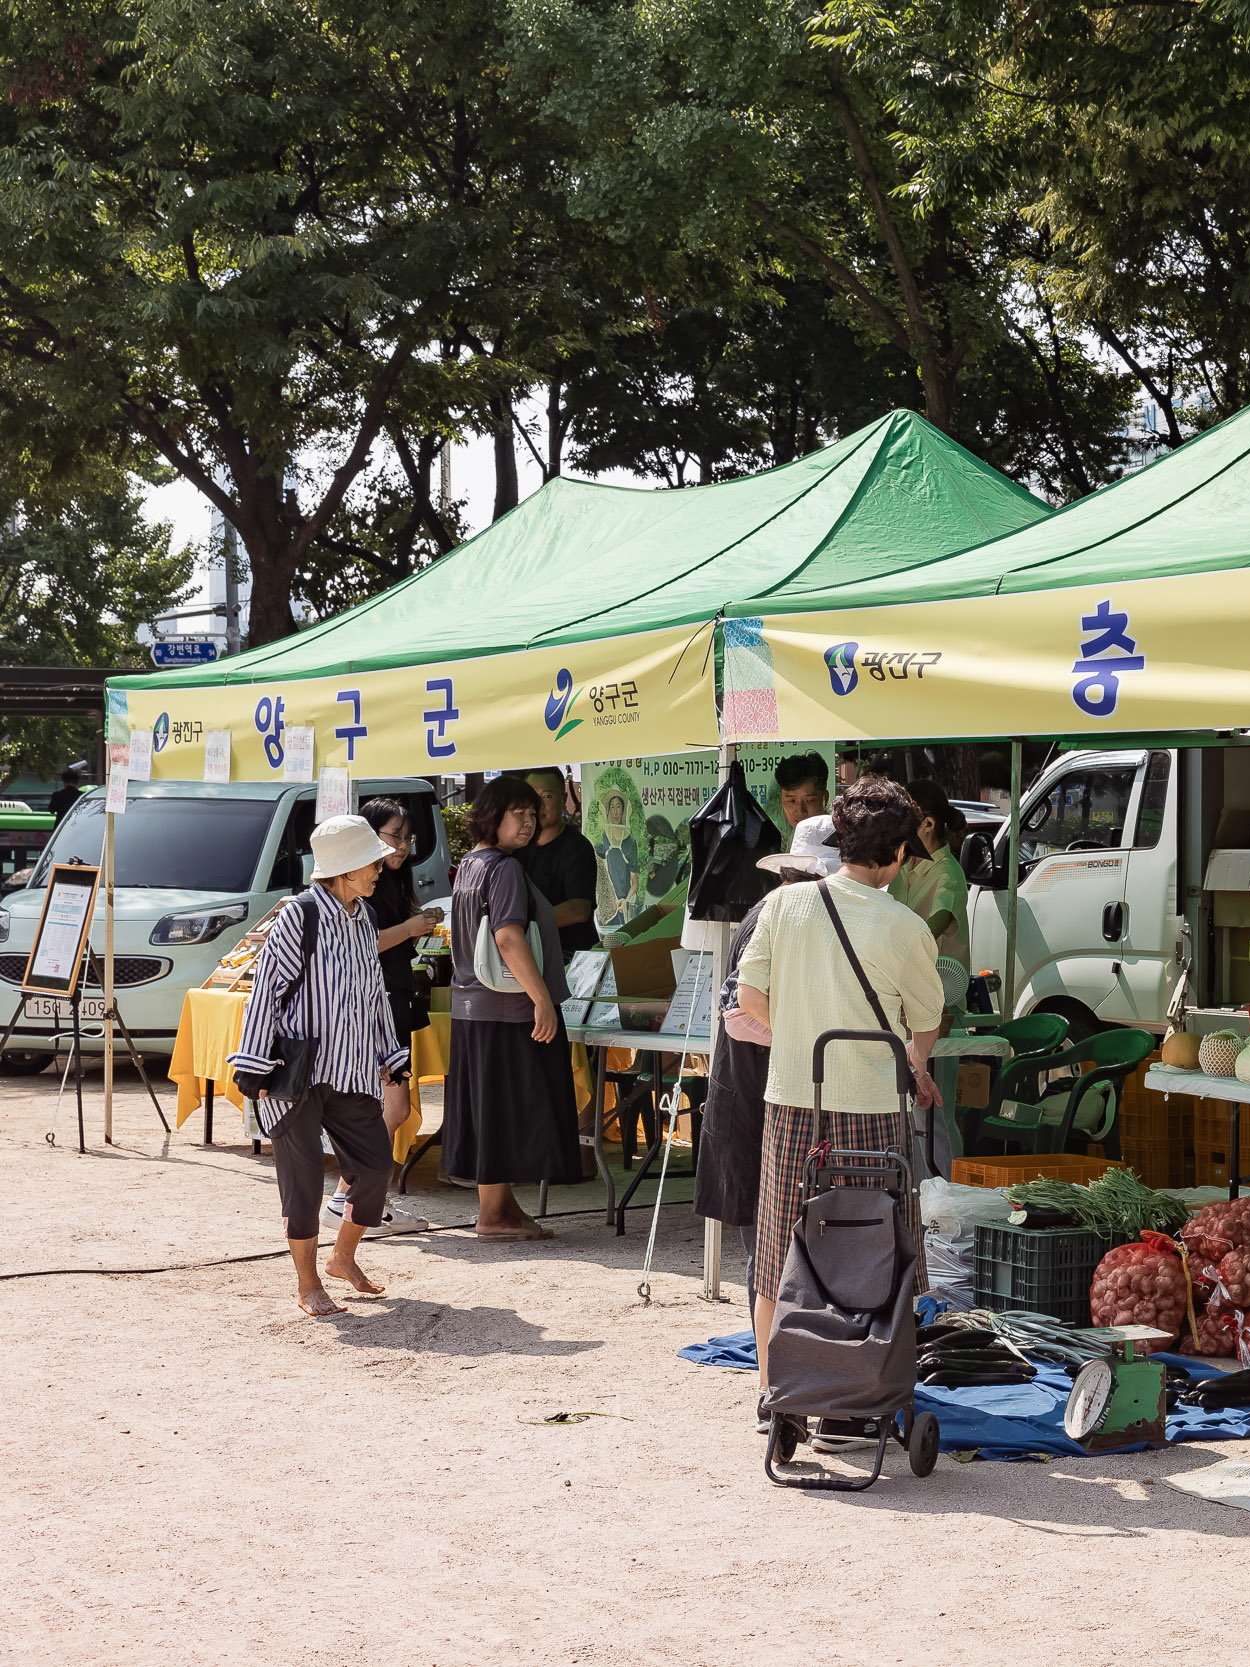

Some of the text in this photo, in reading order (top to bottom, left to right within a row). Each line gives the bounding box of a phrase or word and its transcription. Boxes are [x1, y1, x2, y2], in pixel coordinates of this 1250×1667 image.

[168, 644, 202, 656] 강변역로
[1070, 599, 1146, 717] 충
[860, 651, 943, 682] 광진구
[589, 680, 639, 713] 양구군
[172, 721, 204, 744] 광진구
[254, 678, 459, 769] 양 구 군
[592, 711, 641, 728] YANGGU COUNTY
[641, 787, 666, 806] 생산자
[667, 786, 700, 807] 직접판매
